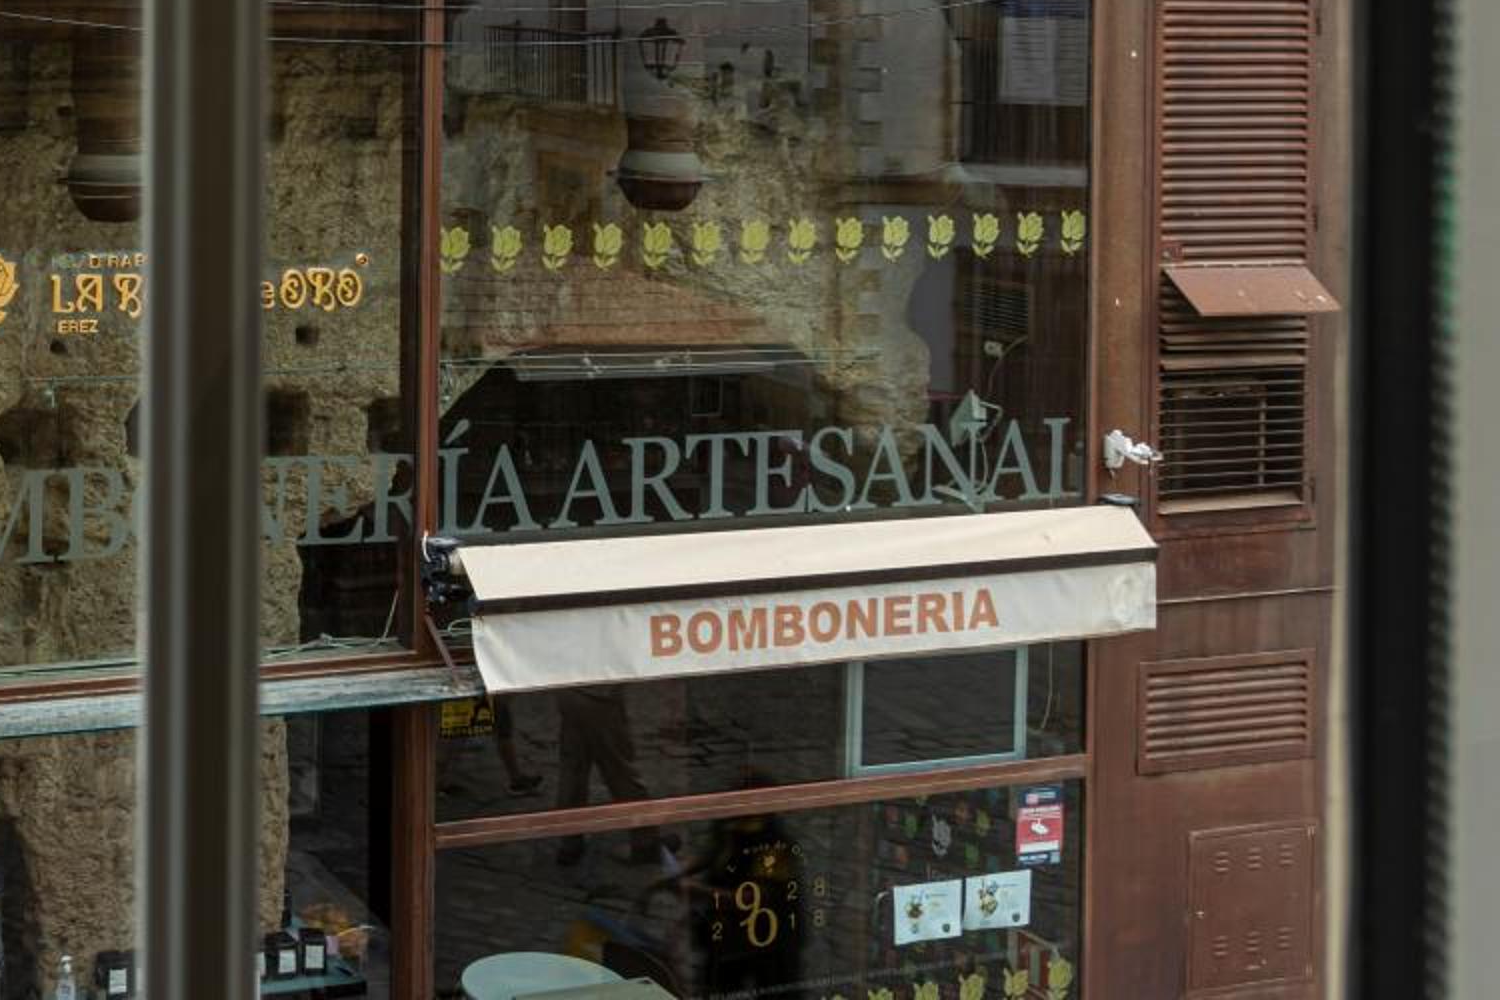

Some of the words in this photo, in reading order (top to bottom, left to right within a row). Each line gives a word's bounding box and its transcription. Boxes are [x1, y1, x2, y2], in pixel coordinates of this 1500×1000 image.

[50, 273, 104, 314] LA
[280, 267, 363, 312] ORO
[548, 417, 1081, 531] ARTESANAL
[649, 588, 1000, 658] BOMBONERIA
